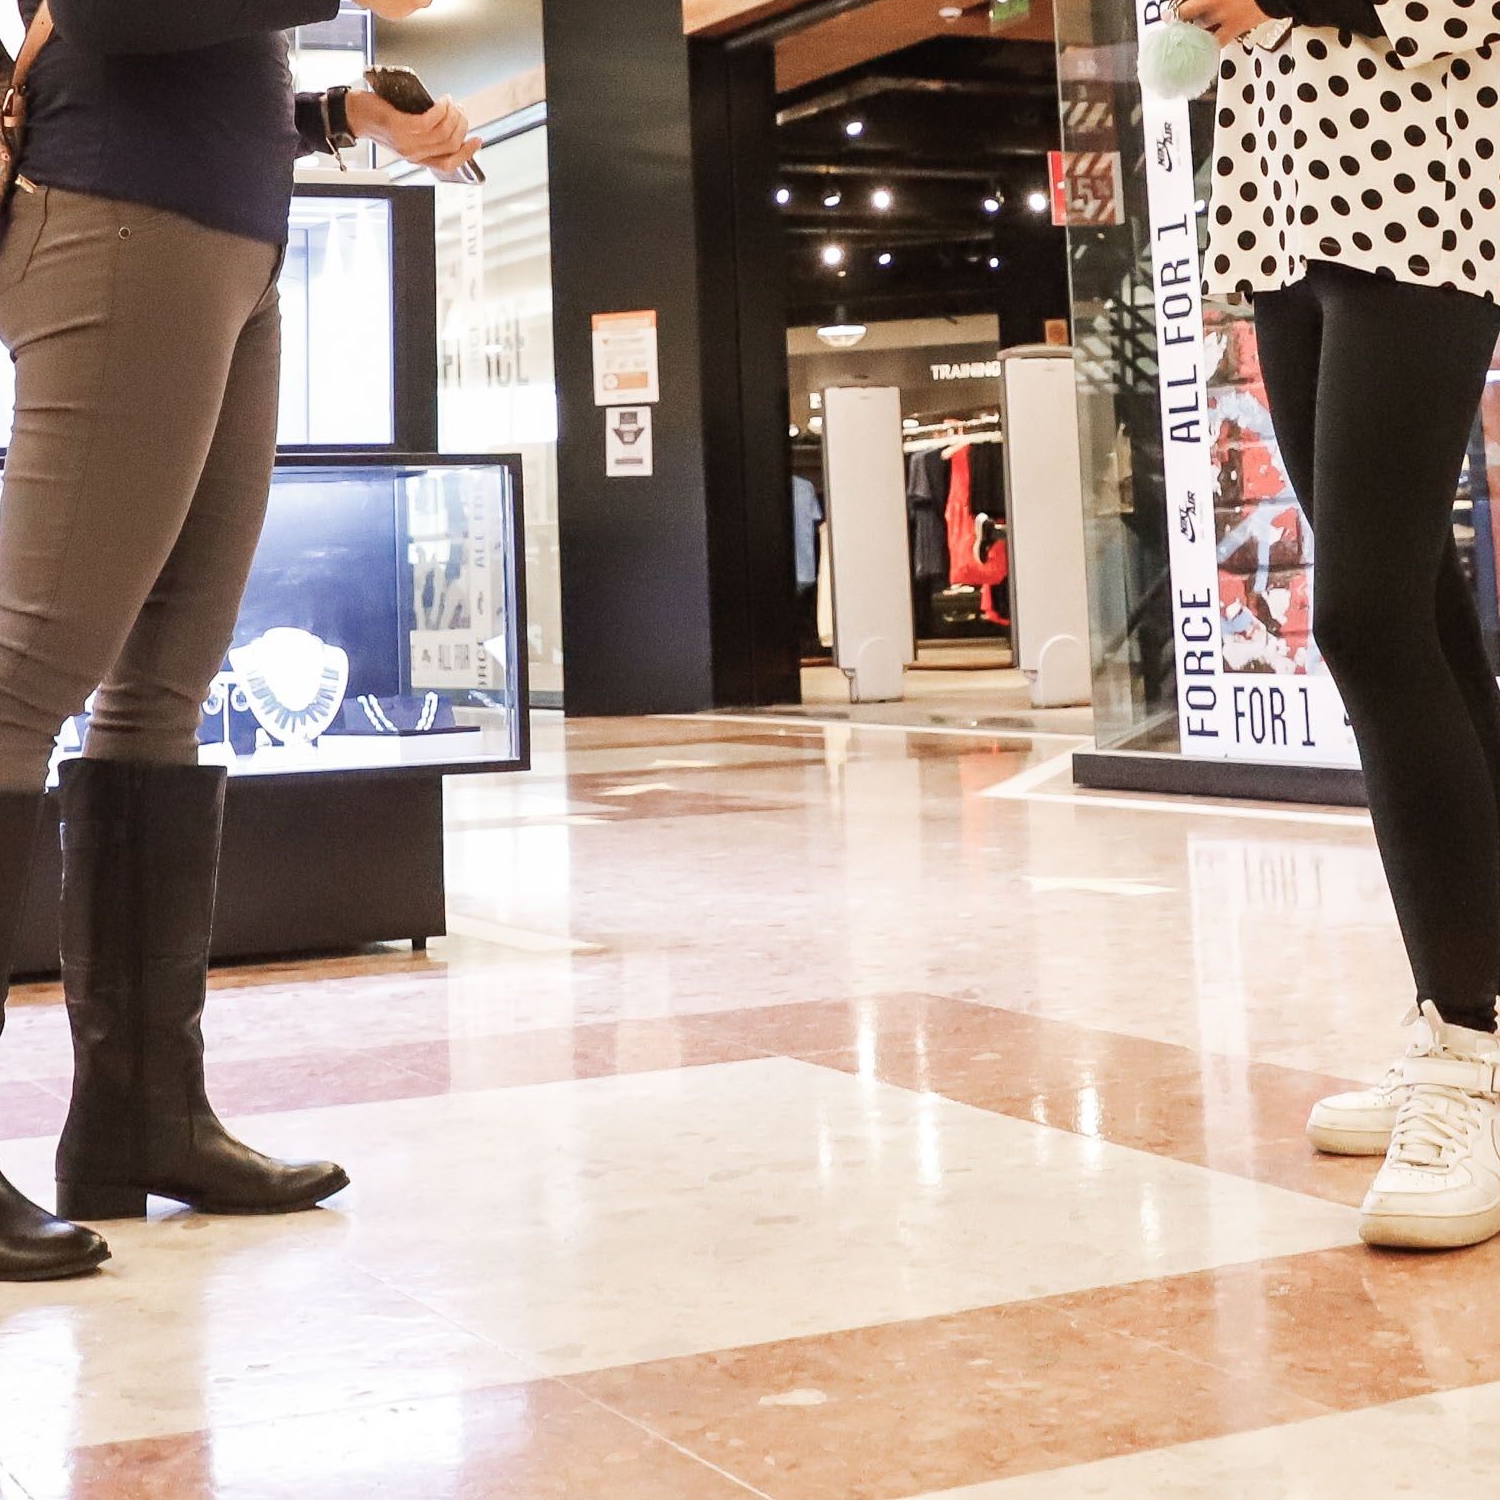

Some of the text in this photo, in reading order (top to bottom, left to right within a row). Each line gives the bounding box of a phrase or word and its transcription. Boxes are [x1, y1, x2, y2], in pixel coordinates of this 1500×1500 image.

[1157, 213, 1201, 443] ALL FOR 1
[1179, 587, 1219, 738] FORCE
[1234, 686, 1316, 747] FOR 1
